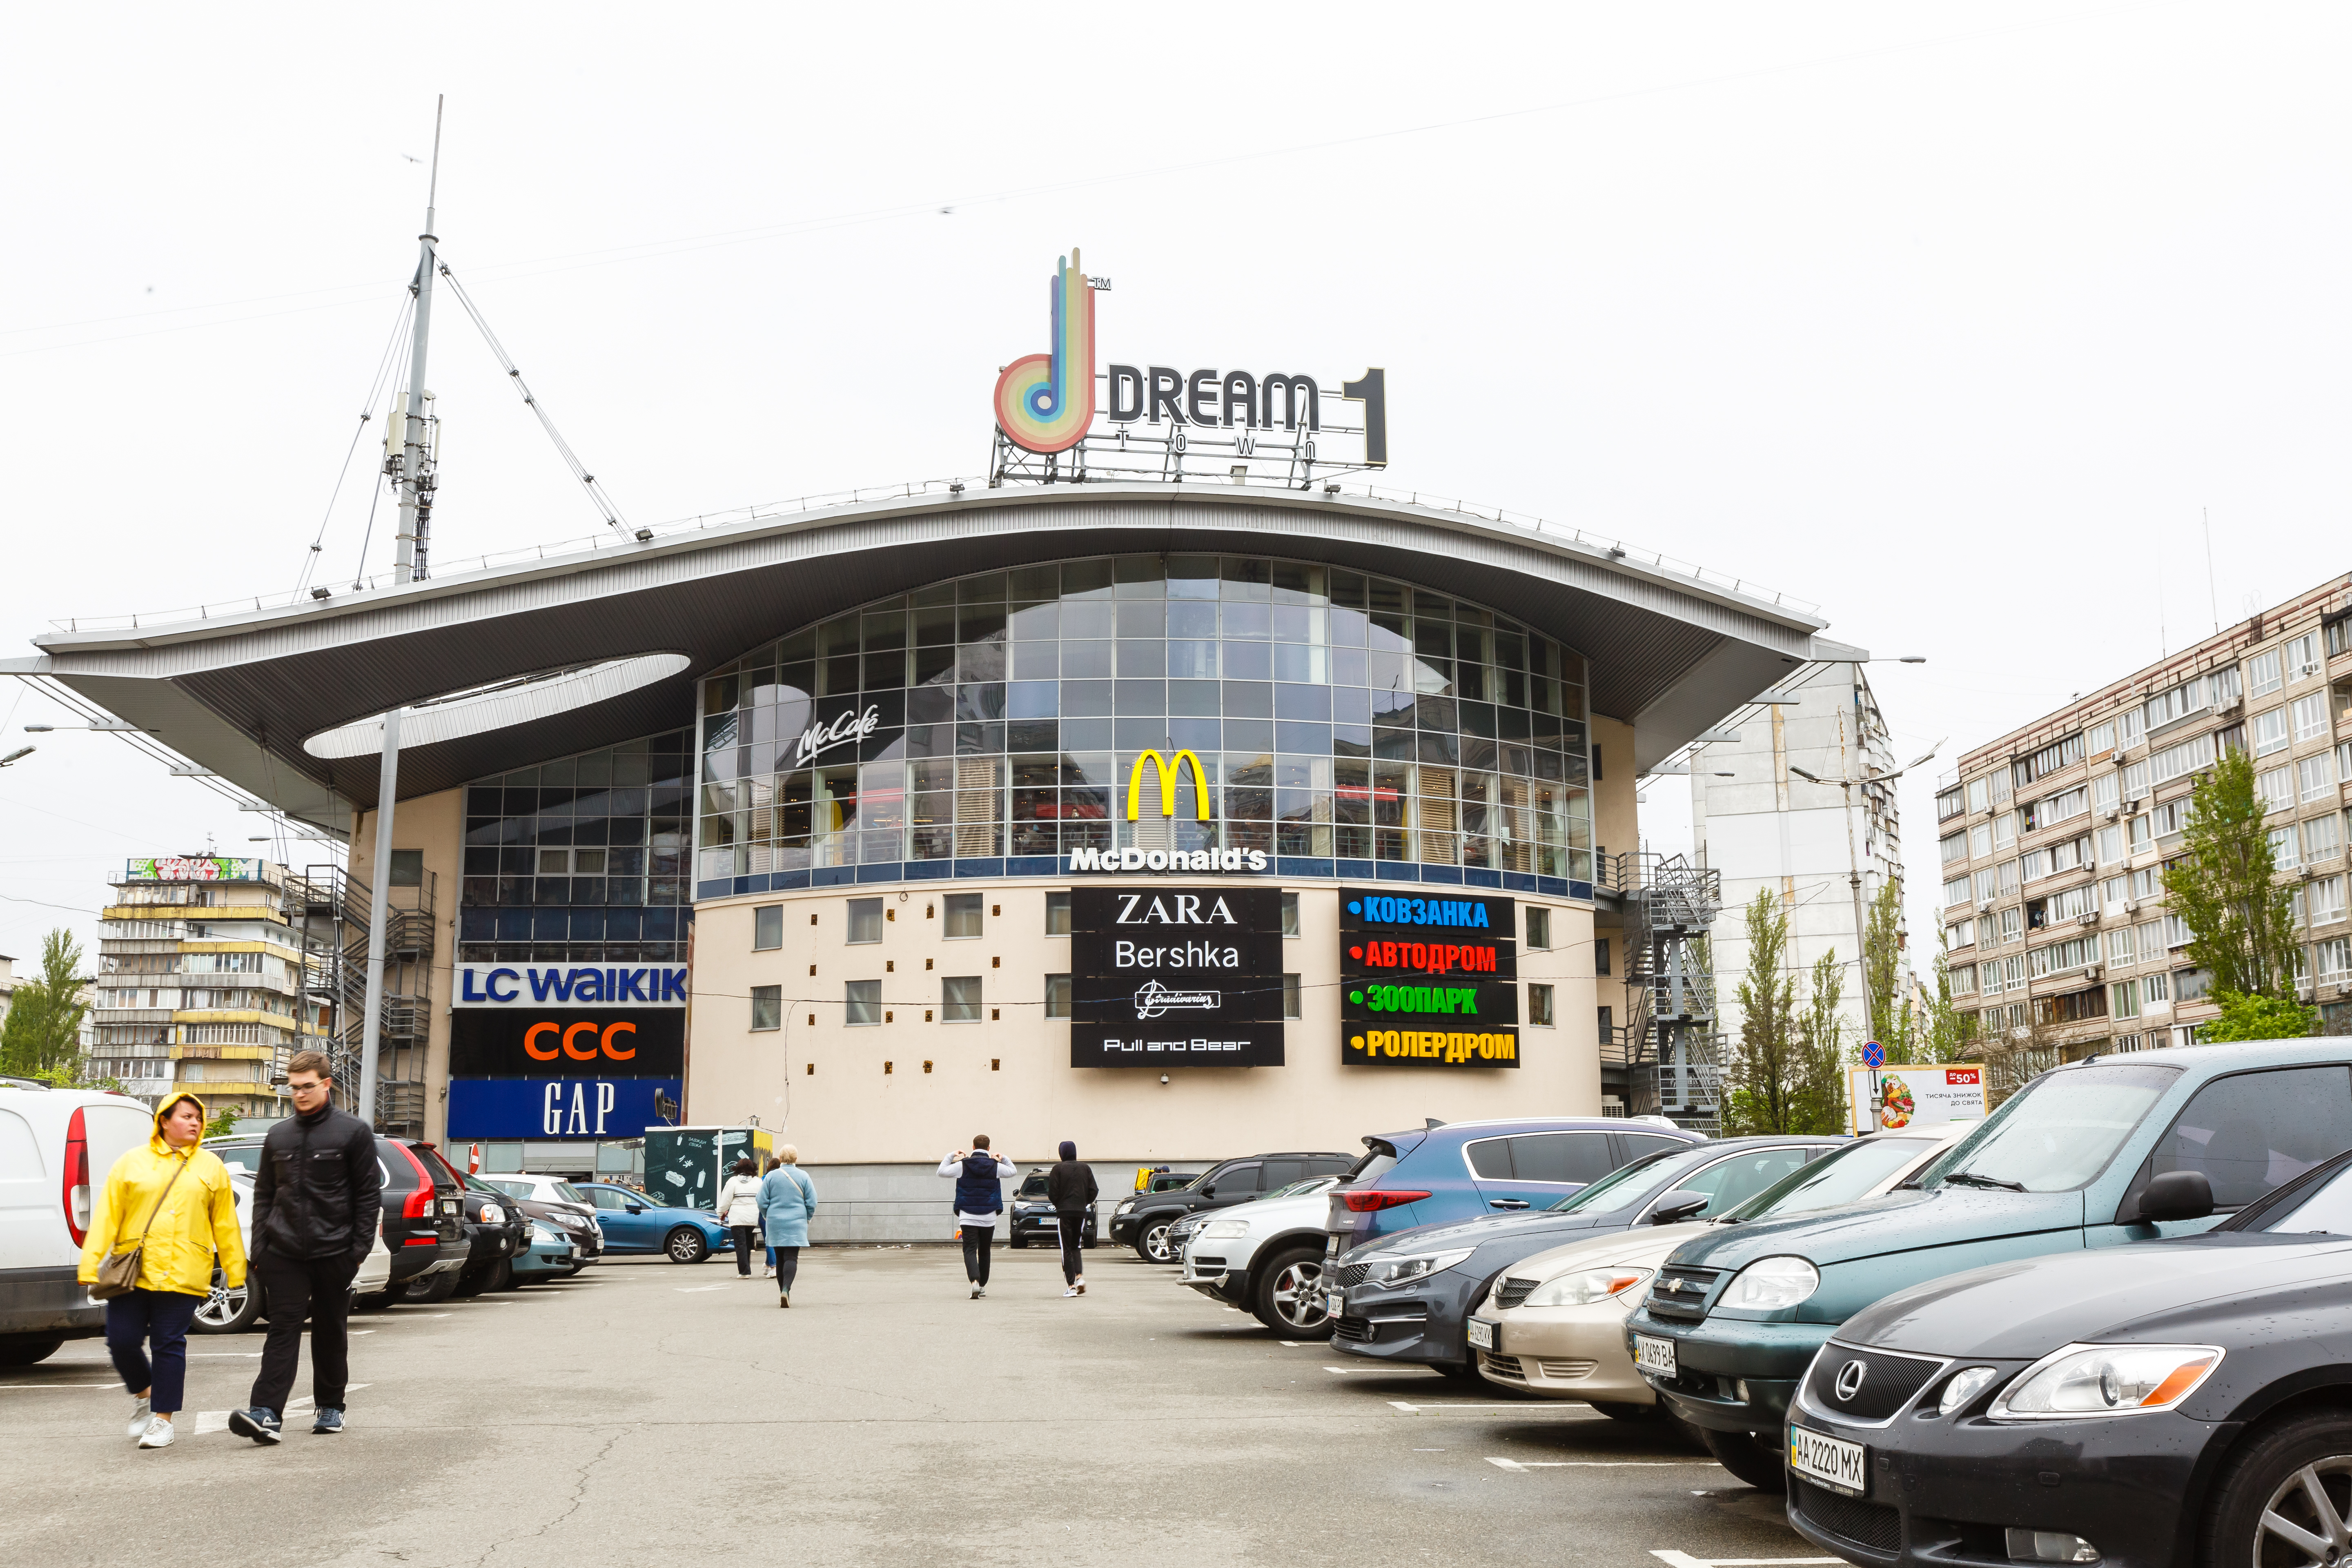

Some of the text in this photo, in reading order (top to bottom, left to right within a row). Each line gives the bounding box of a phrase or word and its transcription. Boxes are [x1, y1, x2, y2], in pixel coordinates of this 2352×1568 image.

[1092, 277, 1111, 290] TM
[1107, 363, 1388, 465] DREAM 1
[796, 704, 879, 760] McCafé
[1069, 847, 1267, 871] McDonald's
[1116, 894, 1238, 924] ZARA
[1364, 896, 1490, 928] КОВЗАНКА
[1116, 941, 1238, 968] Bershka
[1365, 941, 1496, 974] АВТОДРОМ
[462, 968, 687, 1001] LC WAIKIK
[1138, 979, 1214, 1020] Stradivarius
[1368, 984, 1478, 1014] ЗООПАРК
[524, 1022, 636, 1060] CCC
[1104, 1039, 1251, 1051] Pull and Bear
[1367, 1030, 1515, 1063] РОЛЕРДРОМ
[543, 1082, 615, 1135] GAP
[1484, 1327, 1492, 1345] KK
[1637, 1340, 1674, 1368] AX 0699 BA
[1797, 1434, 1862, 1483] AA 2220 MX
